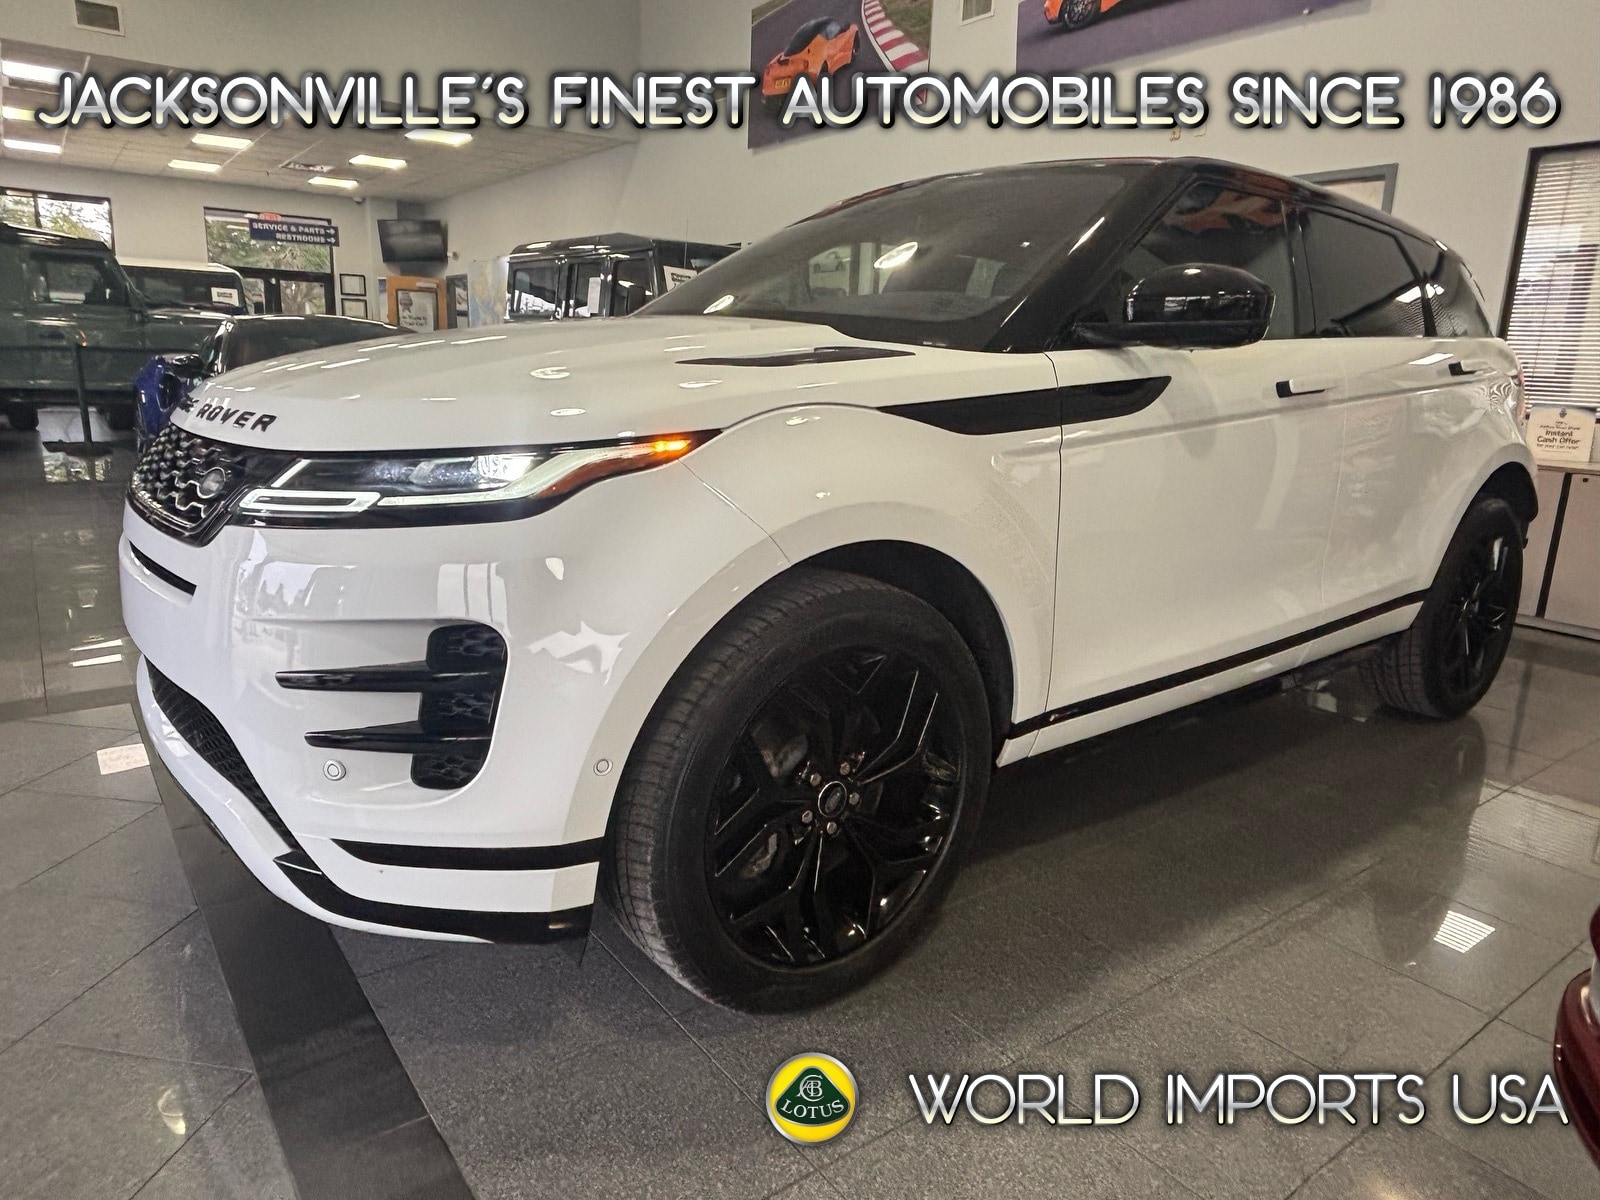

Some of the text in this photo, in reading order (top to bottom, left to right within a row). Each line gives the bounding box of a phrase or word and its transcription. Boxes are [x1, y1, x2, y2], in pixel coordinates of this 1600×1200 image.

[252, 222, 289, 231] SERVICE
[298, 225, 326, 234] PARTS
[275, 232, 326, 243] RESTROOMS
[196, 403, 278, 432] ROVER
